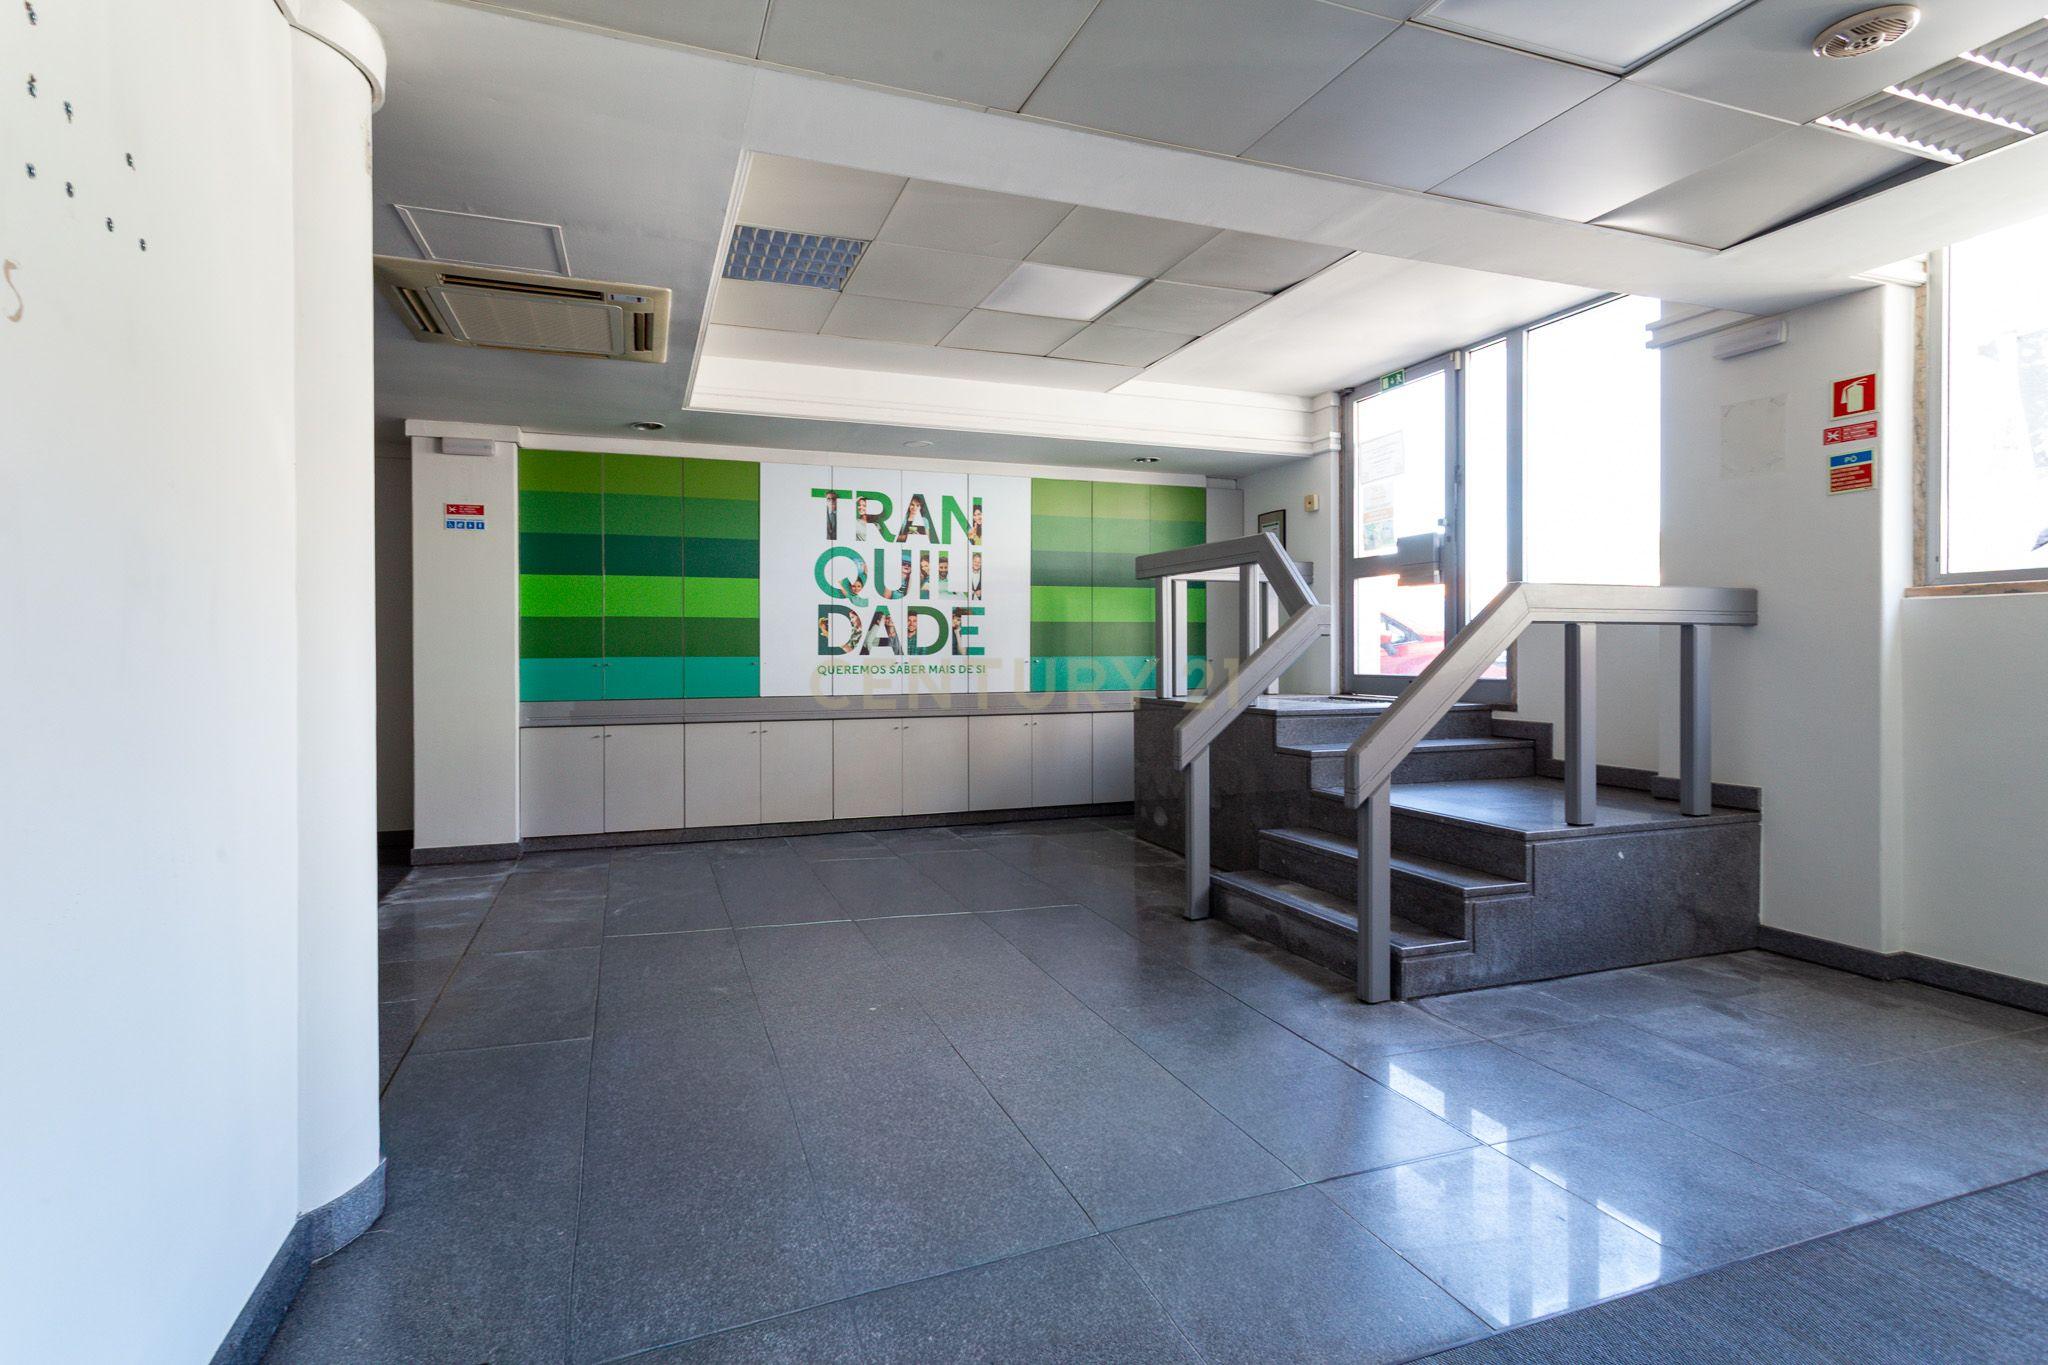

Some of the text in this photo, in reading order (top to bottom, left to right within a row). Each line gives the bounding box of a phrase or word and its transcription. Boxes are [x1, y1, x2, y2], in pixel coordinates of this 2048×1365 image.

[811, 488, 983, 545] TRAN
[814, 546, 982, 607] QUILI
[818, 604, 985, 656] DADE
[817, 664, 986, 675] QUEREMOS SABER MAIS DE SI
